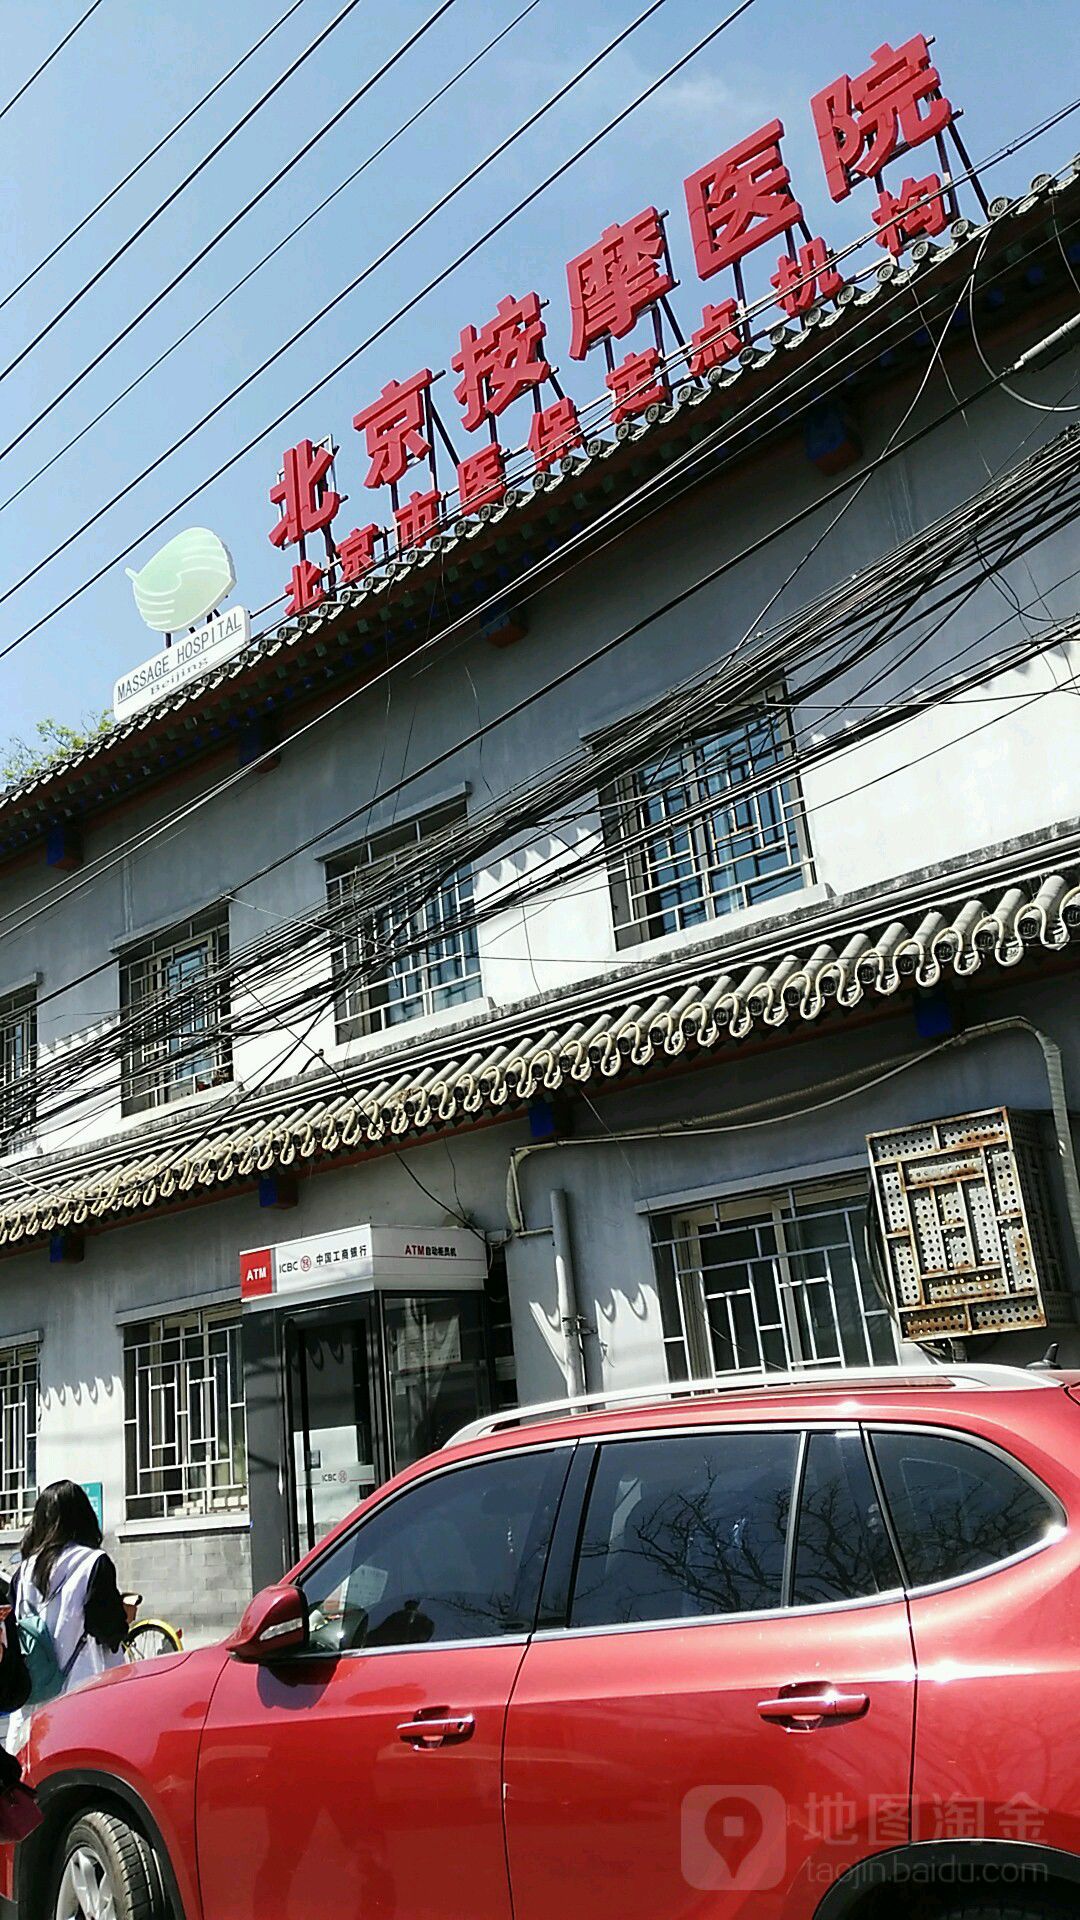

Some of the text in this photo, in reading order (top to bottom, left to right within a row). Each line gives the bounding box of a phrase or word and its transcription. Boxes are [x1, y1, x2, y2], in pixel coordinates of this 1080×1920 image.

[269, 32, 952, 548] 北京按摩医院
[285, 173, 949, 617] 北京市医保定点机构
[117, 612, 242, 700] MASSAGE HOSPITAL
[246, 1266, 268, 1281] ATM
[279, 1261, 299, 1273] ICBC
[316, 1245, 367, 1266] 中国工商银行
